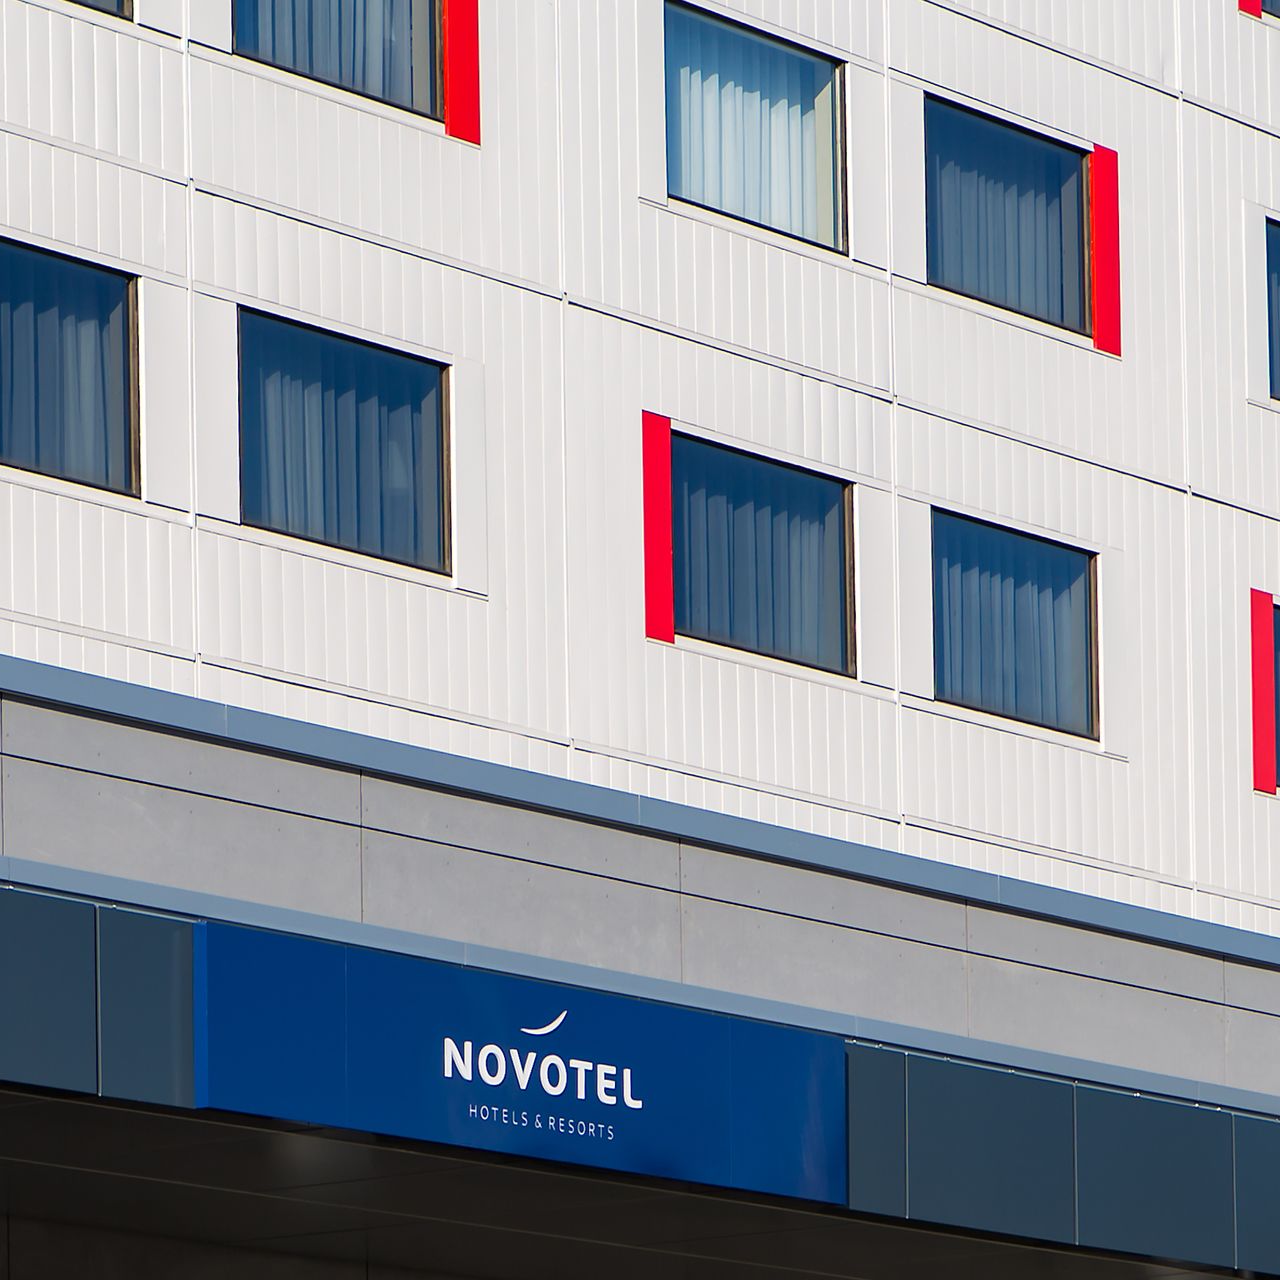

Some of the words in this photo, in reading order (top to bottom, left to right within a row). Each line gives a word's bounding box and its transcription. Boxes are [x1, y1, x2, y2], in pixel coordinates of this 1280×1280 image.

[443, 1037, 643, 1109] NOVOTEL
[469, 1104, 528, 1126] HOTELS
[534, 1114, 543, 1129] &
[548, 1116, 615, 1140] RESORTS
